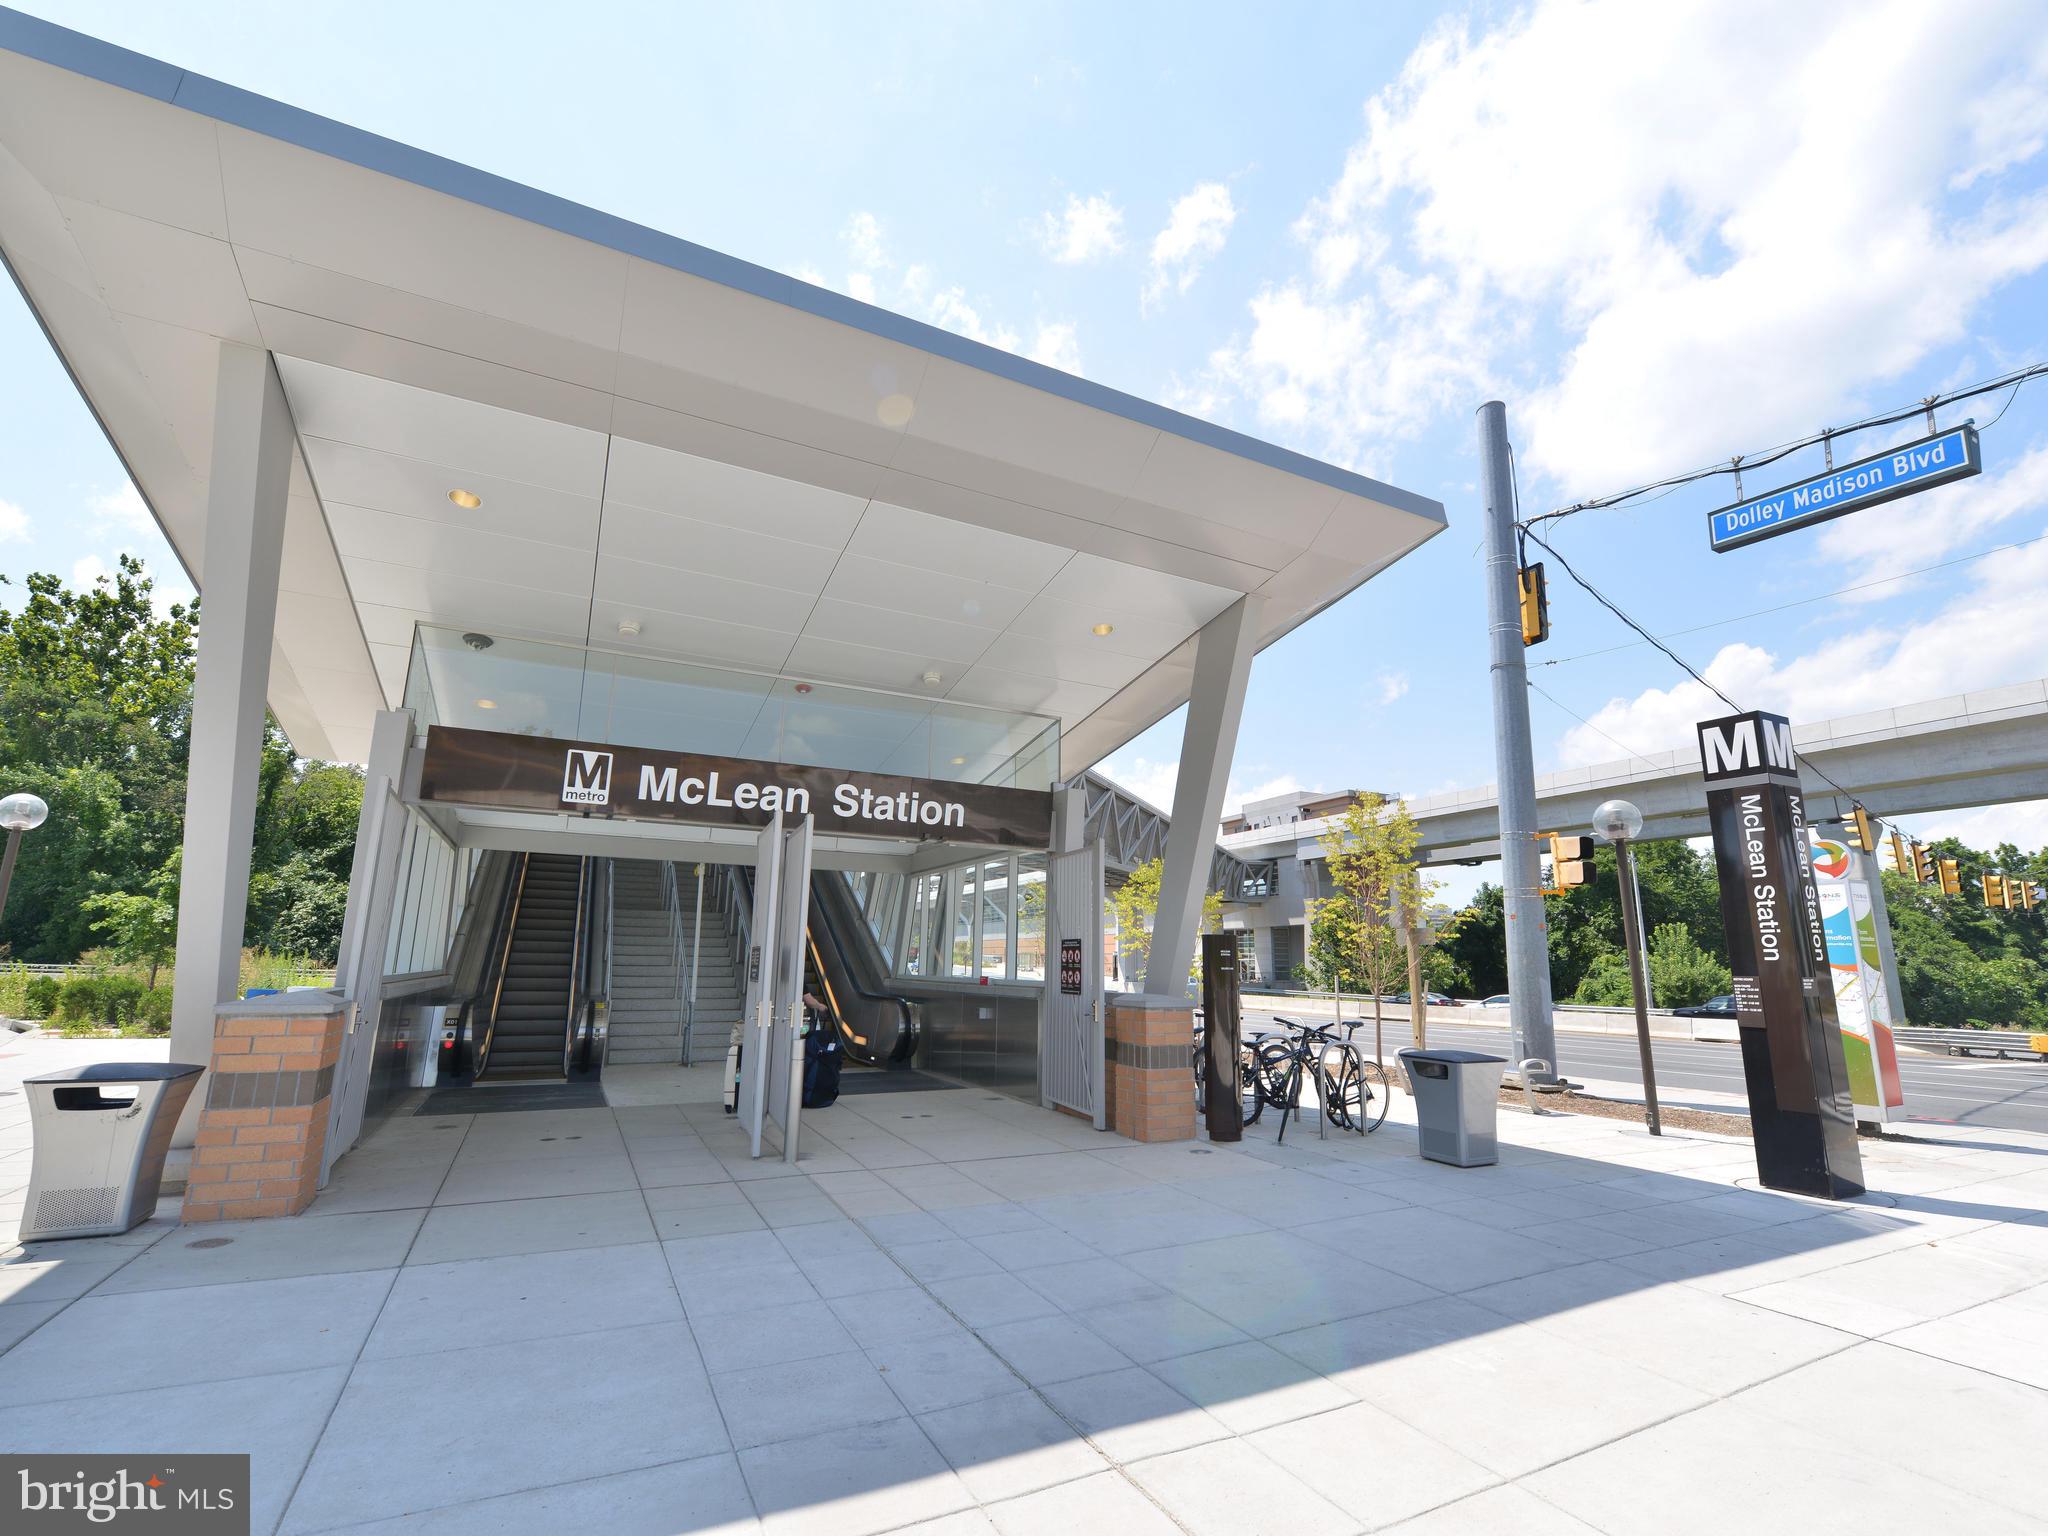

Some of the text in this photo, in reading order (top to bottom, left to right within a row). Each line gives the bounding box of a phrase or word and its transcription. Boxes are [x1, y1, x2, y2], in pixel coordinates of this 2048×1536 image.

[1725, 442, 1946, 531] Dolley Madison Blvd
[567, 751, 610, 790] M
[1702, 719, 1761, 774] M
[1762, 719, 1796, 771] M
[565, 791, 606, 802] metro
[638, 765, 966, 827] McLean Station
[1740, 794, 1781, 961] McLean Station
[1789, 795, 1811, 878] McLean
[1805, 886, 1824, 961] Station
